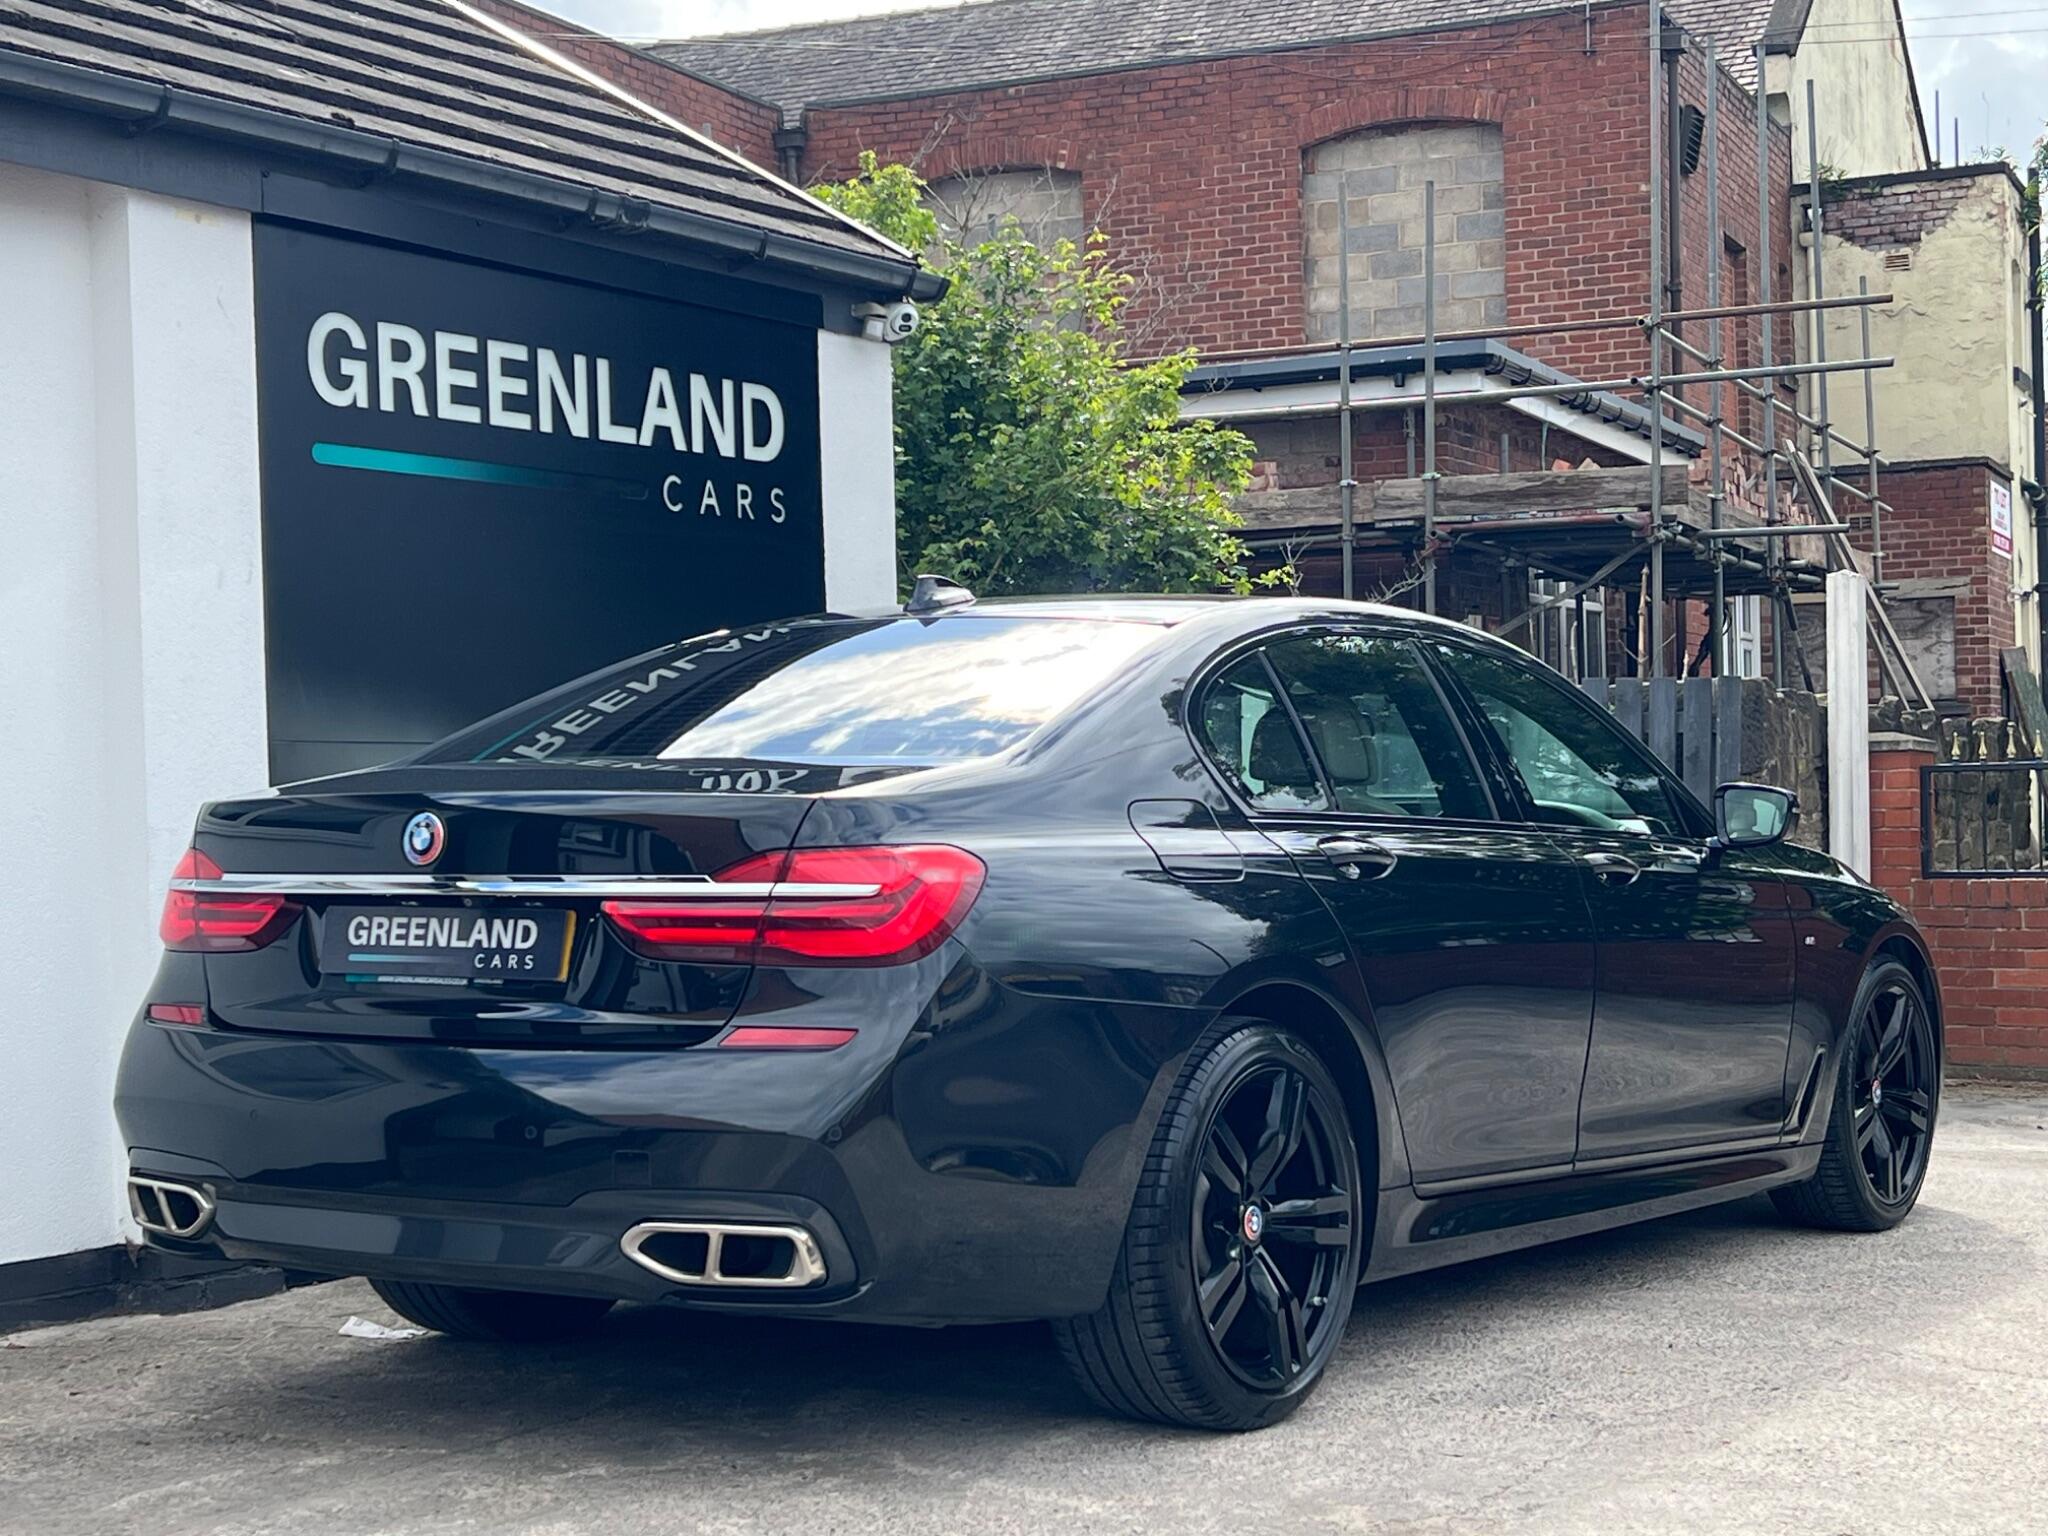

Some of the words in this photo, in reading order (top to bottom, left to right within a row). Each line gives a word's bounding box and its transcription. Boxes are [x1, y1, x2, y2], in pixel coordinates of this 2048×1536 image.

[307, 312, 785, 463] GREENLAND
[662, 474, 787, 524] CARS
[347, 915, 539, 950] GREENLAND
[474, 953, 535, 970] CARS
